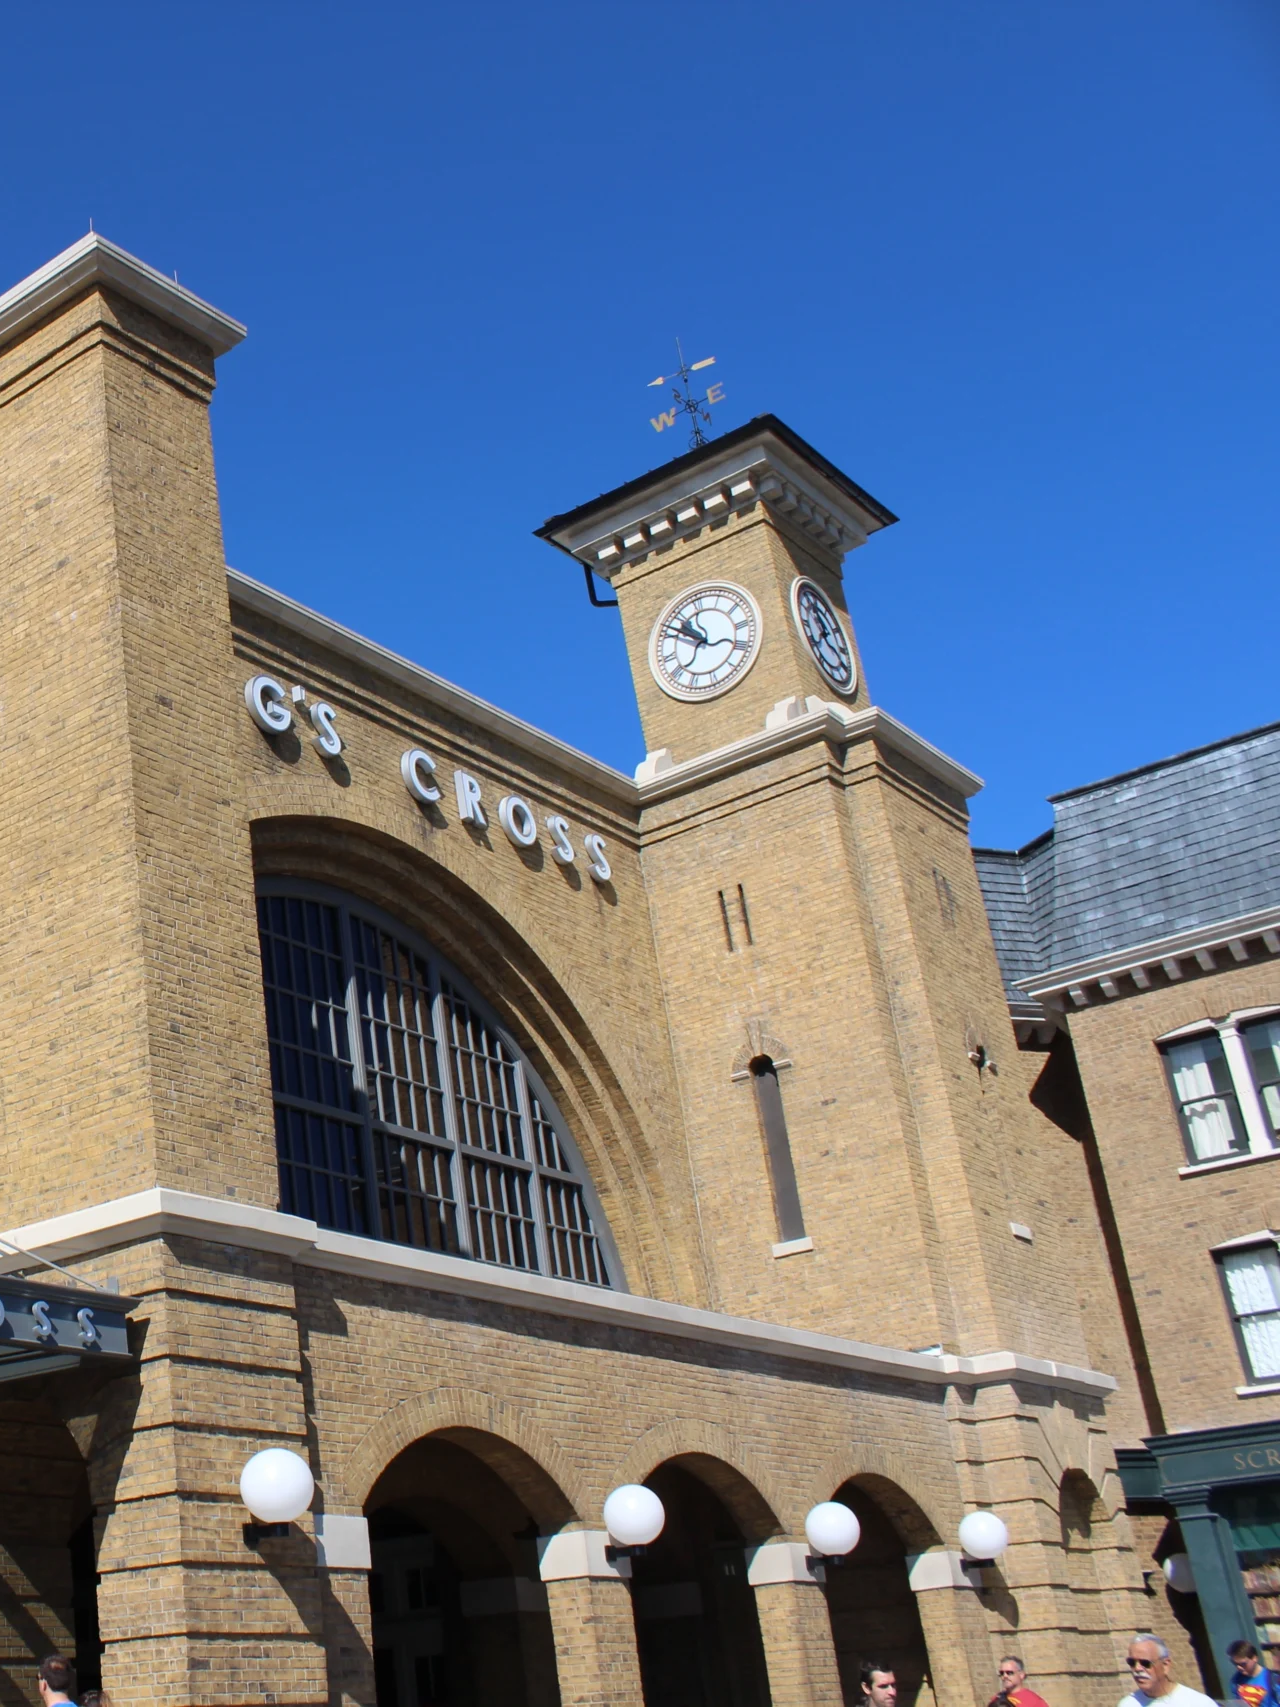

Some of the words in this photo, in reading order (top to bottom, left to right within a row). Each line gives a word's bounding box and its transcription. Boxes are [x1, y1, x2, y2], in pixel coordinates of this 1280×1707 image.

[706, 381, 726, 405] E
[650, 407, 676, 433] W
[401, 748, 611, 882] CROSS
[1233, 1448, 1280, 1470] SCR
